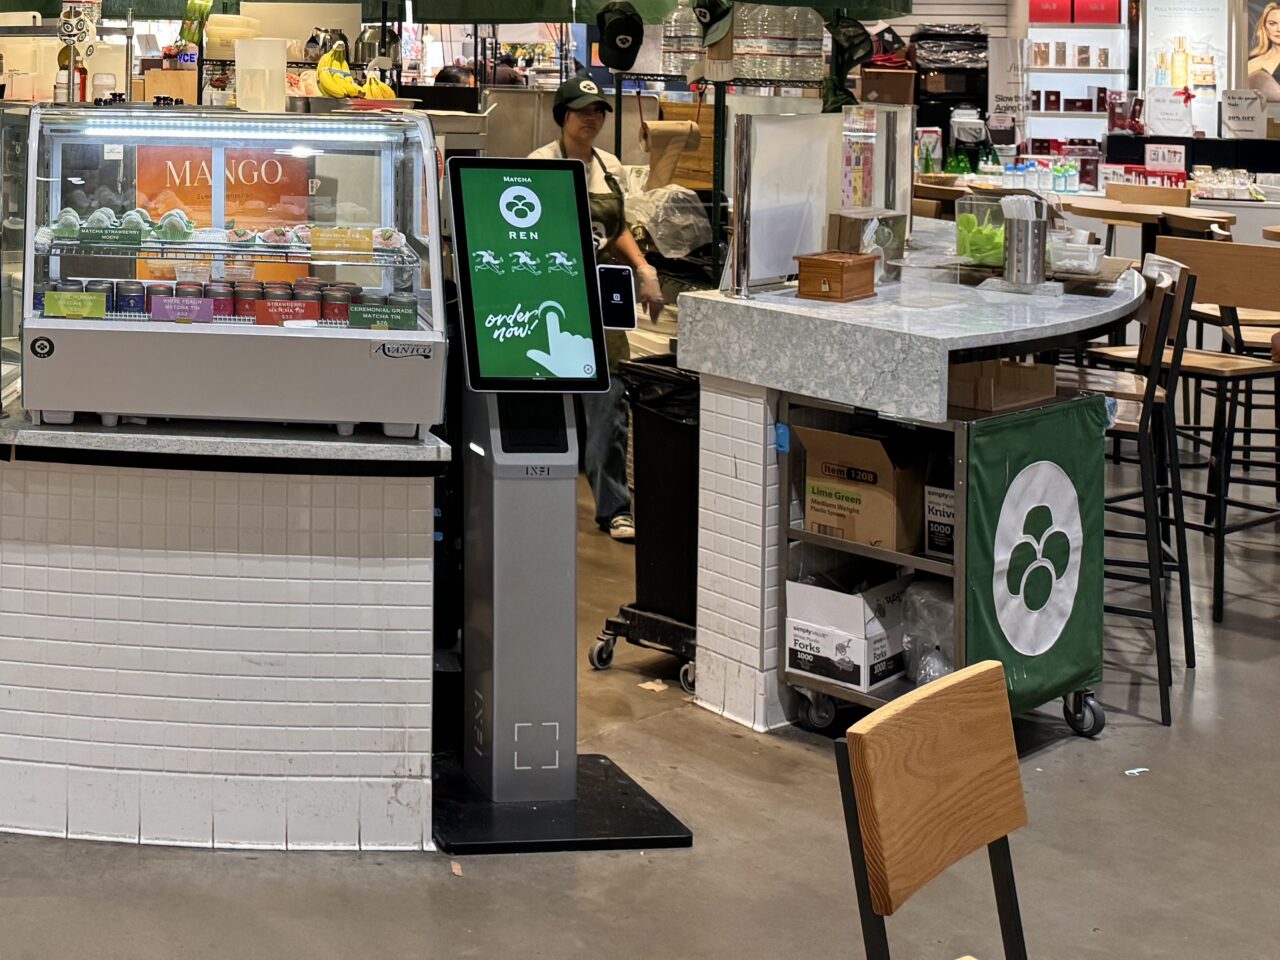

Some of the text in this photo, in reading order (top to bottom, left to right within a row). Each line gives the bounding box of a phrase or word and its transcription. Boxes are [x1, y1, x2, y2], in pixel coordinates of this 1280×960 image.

[165, 159, 283, 188] MANGO
[509, 231, 538, 240] REN
[485, 304, 538, 328] order
[493, 320, 538, 342] now!
[374, 343, 432, 357] AVANTCO
[824, 463, 874, 481] Item 120B
[812, 486, 862, 505] Lime Green
[810, 498, 860, 515] Medium Weight
[930, 523, 951, 534] 1000
[793, 638, 820, 654] Forks
[797, 652, 813, 661] 1000
[873, 651, 887, 662] Forks
